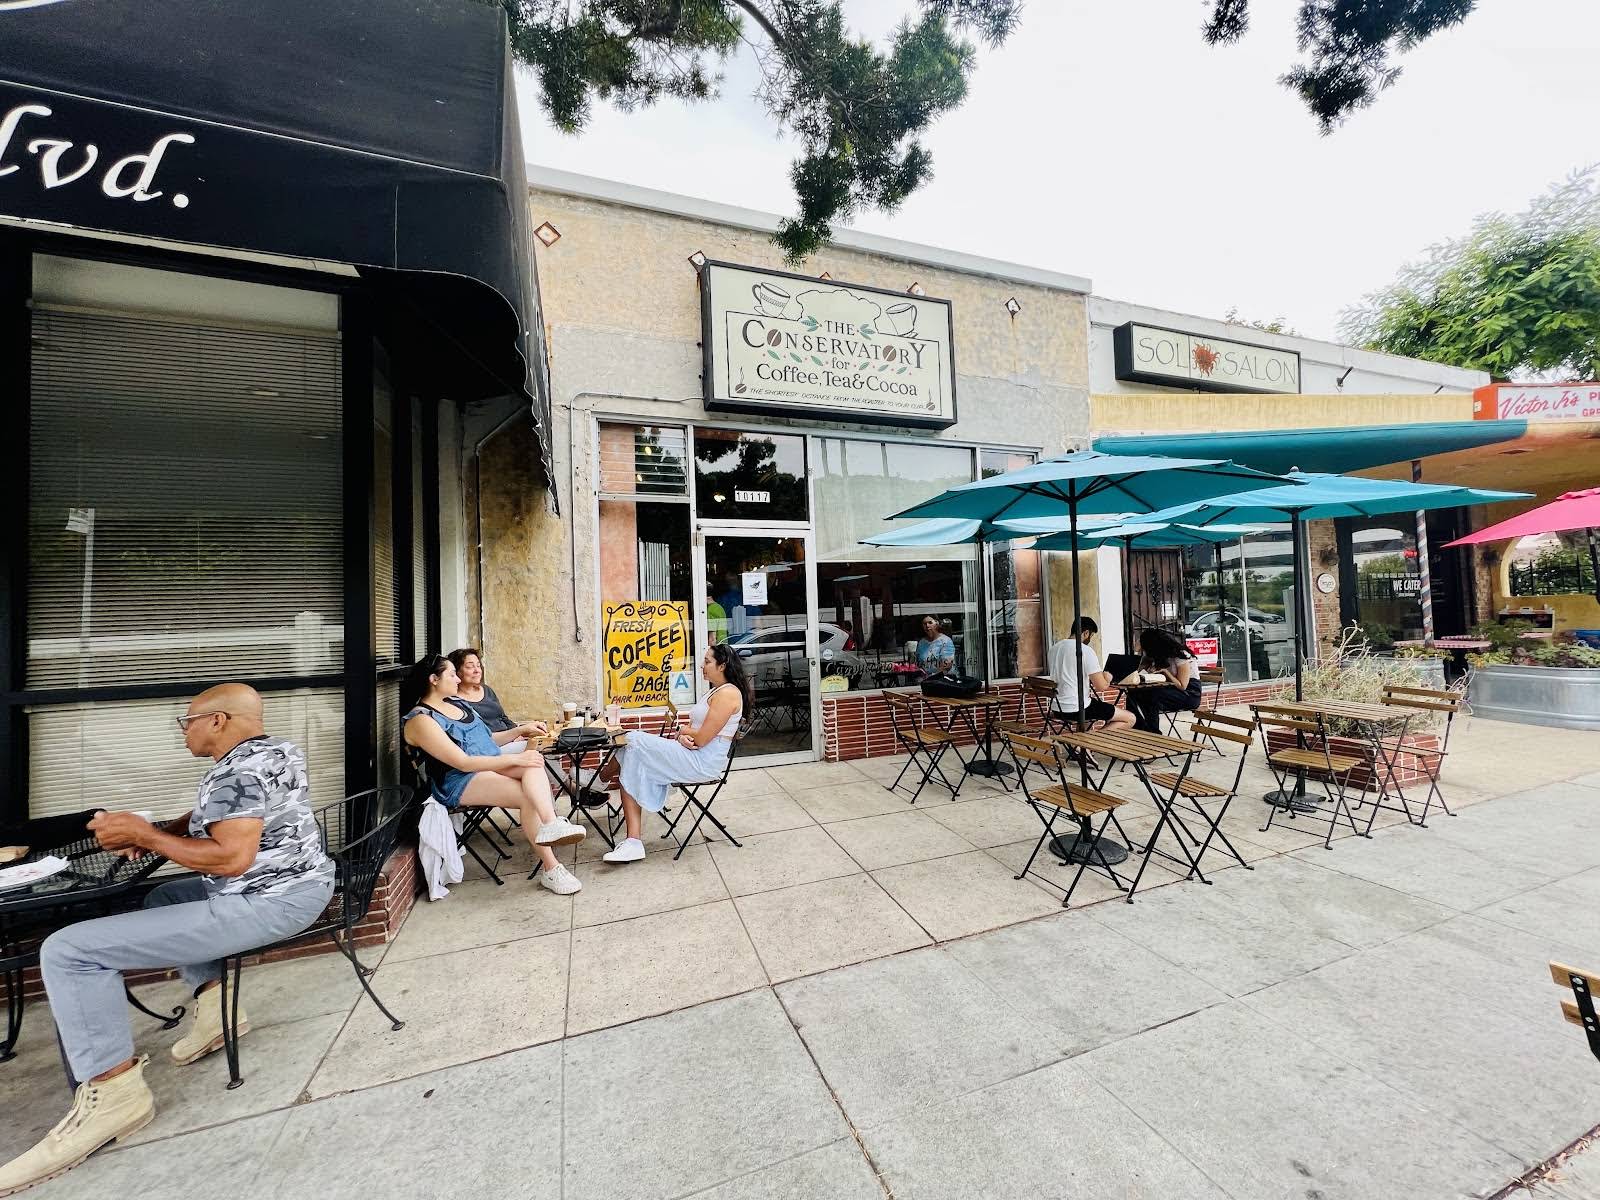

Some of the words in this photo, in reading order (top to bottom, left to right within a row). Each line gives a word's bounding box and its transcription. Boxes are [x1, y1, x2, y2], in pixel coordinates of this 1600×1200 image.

[824, 319, 856, 336] THE
[742, 319, 927, 369] CONSERVATORY
[832, 357, 851, 370] for
[1136, 337, 1189, 369] SOL
[1222, 352, 1296, 384] SALON
[1500, 392, 1550, 419] Victor
[736, 491, 769, 502] 10117
[1392, 580, 1403, 591] WE
[1403, 580, 1422, 591] CATER
[612, 620, 655, 633] FRESH
[608, 622, 682, 670] COFFEE
[674, 673, 689, 689] A
[611, 694, 632, 705] PARK
[635, 694, 645, 702] IN
[645, 693, 667, 702] BACK
